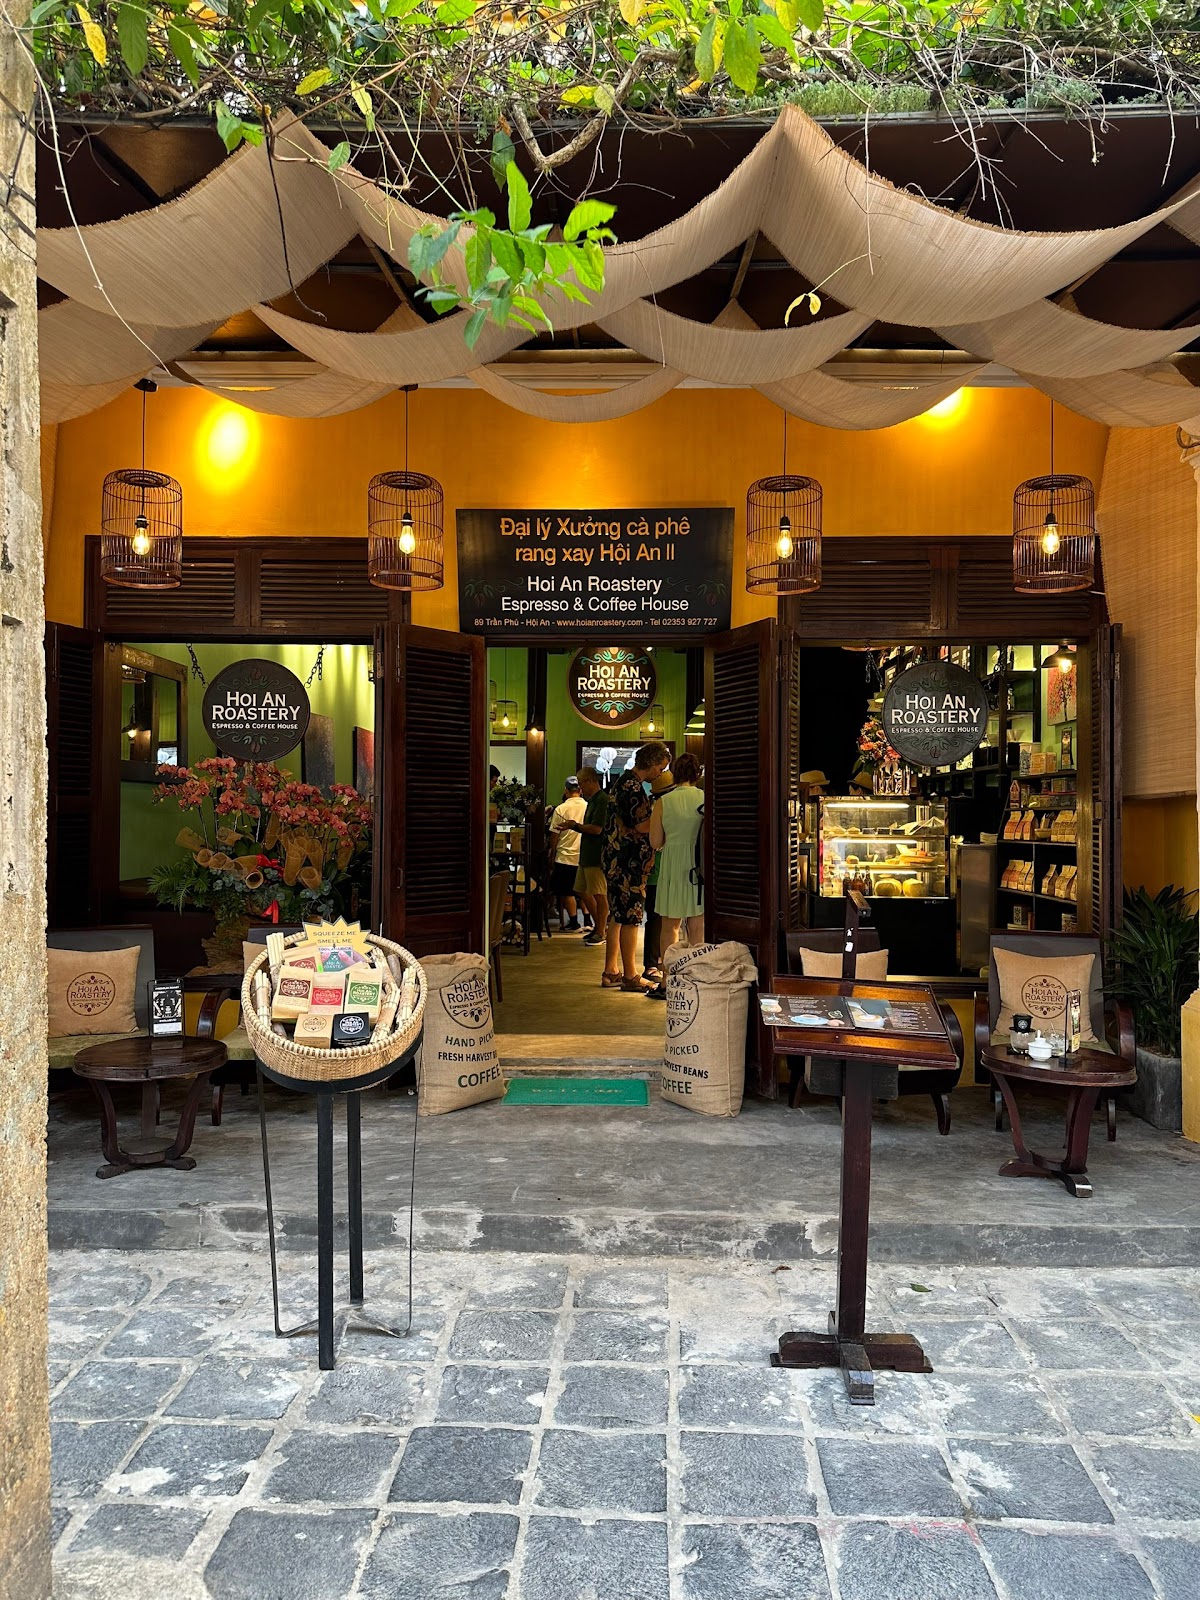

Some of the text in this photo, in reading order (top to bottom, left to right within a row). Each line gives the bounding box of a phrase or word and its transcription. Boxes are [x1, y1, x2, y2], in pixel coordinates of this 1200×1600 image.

[500, 515, 691, 540] Đại lý Xưởng cà phê
[515, 546, 556, 565] rang
[562, 547, 594, 566] xay
[600, 543, 631, 565] Hội
[636, 544, 661, 561] An
[527, 576, 662, 595] Hoi An Roastery
[501, 597, 689, 614] Espresso & Coffee House
[474, 618, 484, 626] 89
[504, 618, 519, 626] Phú
[525, 618, 539, 628] Hội
[540, 618, 550, 626] An
[556, 618, 643, 628] www.hoianroastery.com
[650, 618, 661, 626] Tel
[662, 618, 686, 626] 02353
[687, 618, 701, 626] 927
[703, 618, 717, 626] 727
[589, 665, 640, 679] HOI AN
[577, 677, 652, 691] ROASTERY
[226, 691, 286, 707] HOI AN
[905, 694, 966, 710] HOI AN
[212, 705, 301, 721] ROASTERY
[891, 707, 981, 724] ROASTERY
[251, 722, 276, 730] COFFEE
[447, 986, 488, 1003] ROASTER
[454, 982, 471, 993] HOI
[674, 991, 686, 1000] AN
[445, 1035, 476, 1047] HAND
[438, 1051, 464, 1062] FRESH
[466, 1051, 492, 1062] HARVEST
[670, 1044, 699, 1056] PICKED
[458, 1063, 500, 1088] COFFEE
[683, 1066, 709, 1079] BEANS
[662, 1076, 692, 1095] OFFEE
